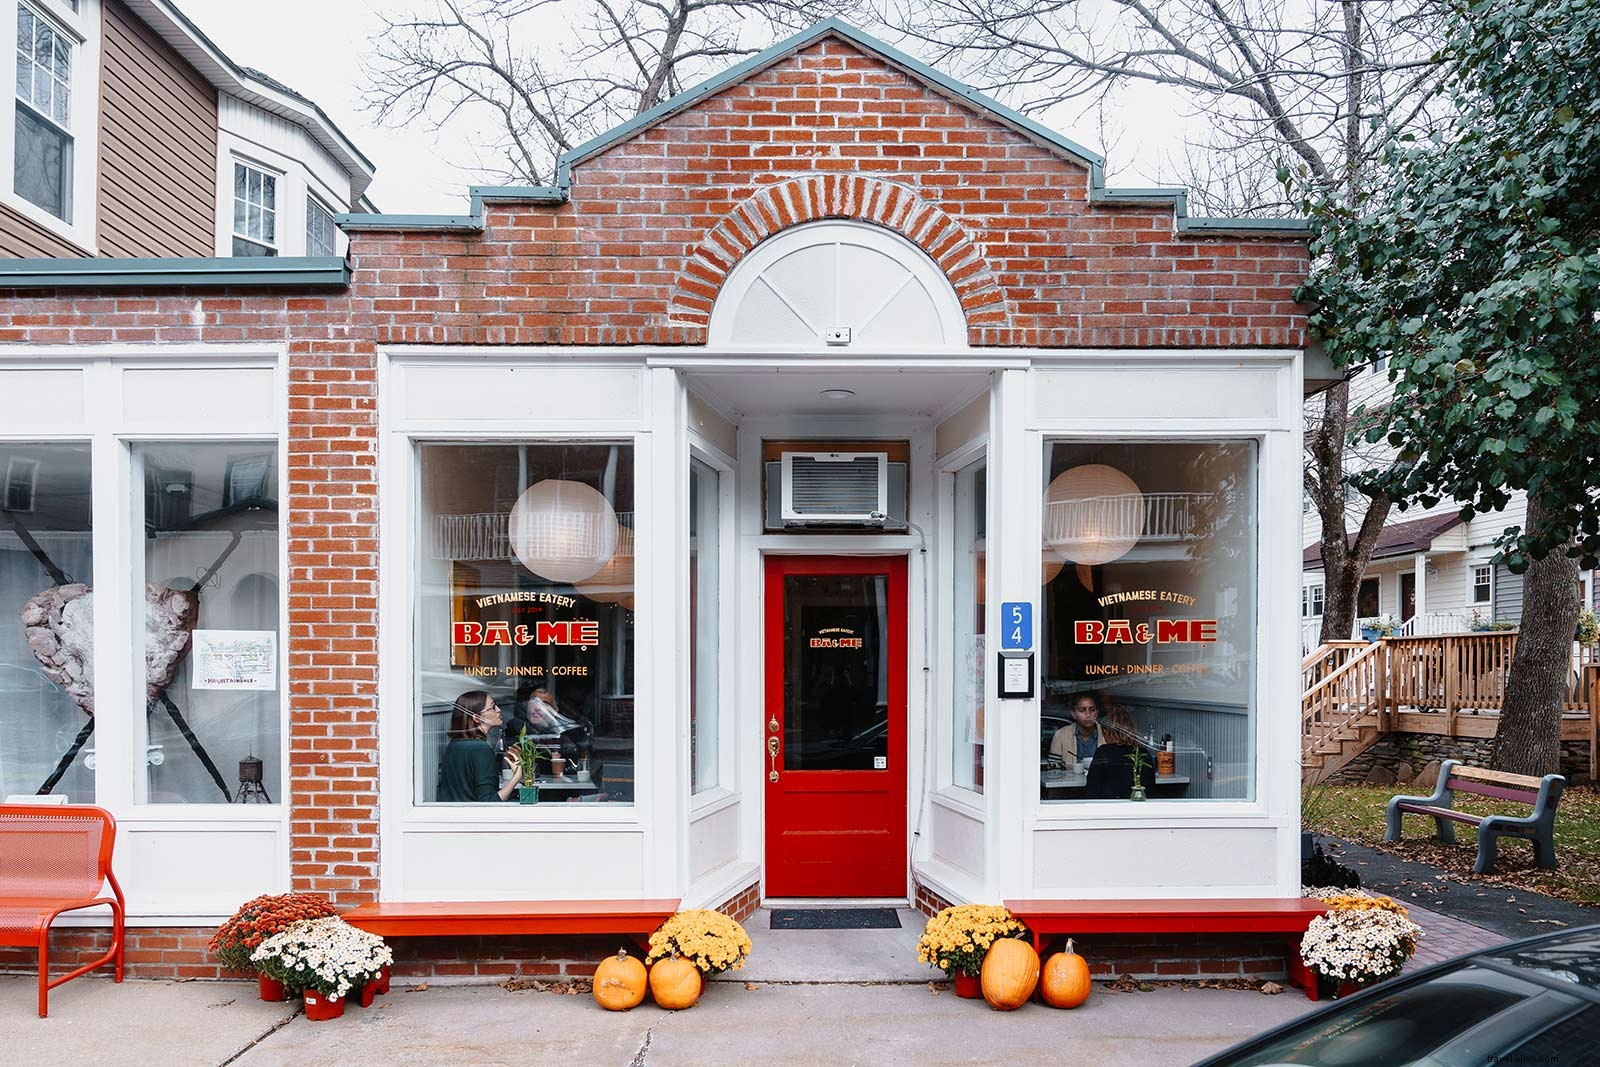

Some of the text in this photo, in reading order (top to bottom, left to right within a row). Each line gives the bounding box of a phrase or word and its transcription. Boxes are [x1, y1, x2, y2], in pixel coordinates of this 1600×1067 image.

[476, 591, 576, 609] VIETNAMESE EATERY
[1098, 590, 1196, 607] VIETNAMESE EATERY
[464, 665, 588, 676] LUNCH DINNER COFFEE
[1085, 664, 1118, 674] LUNCH
[1127, 664, 1163, 674] DINNER
